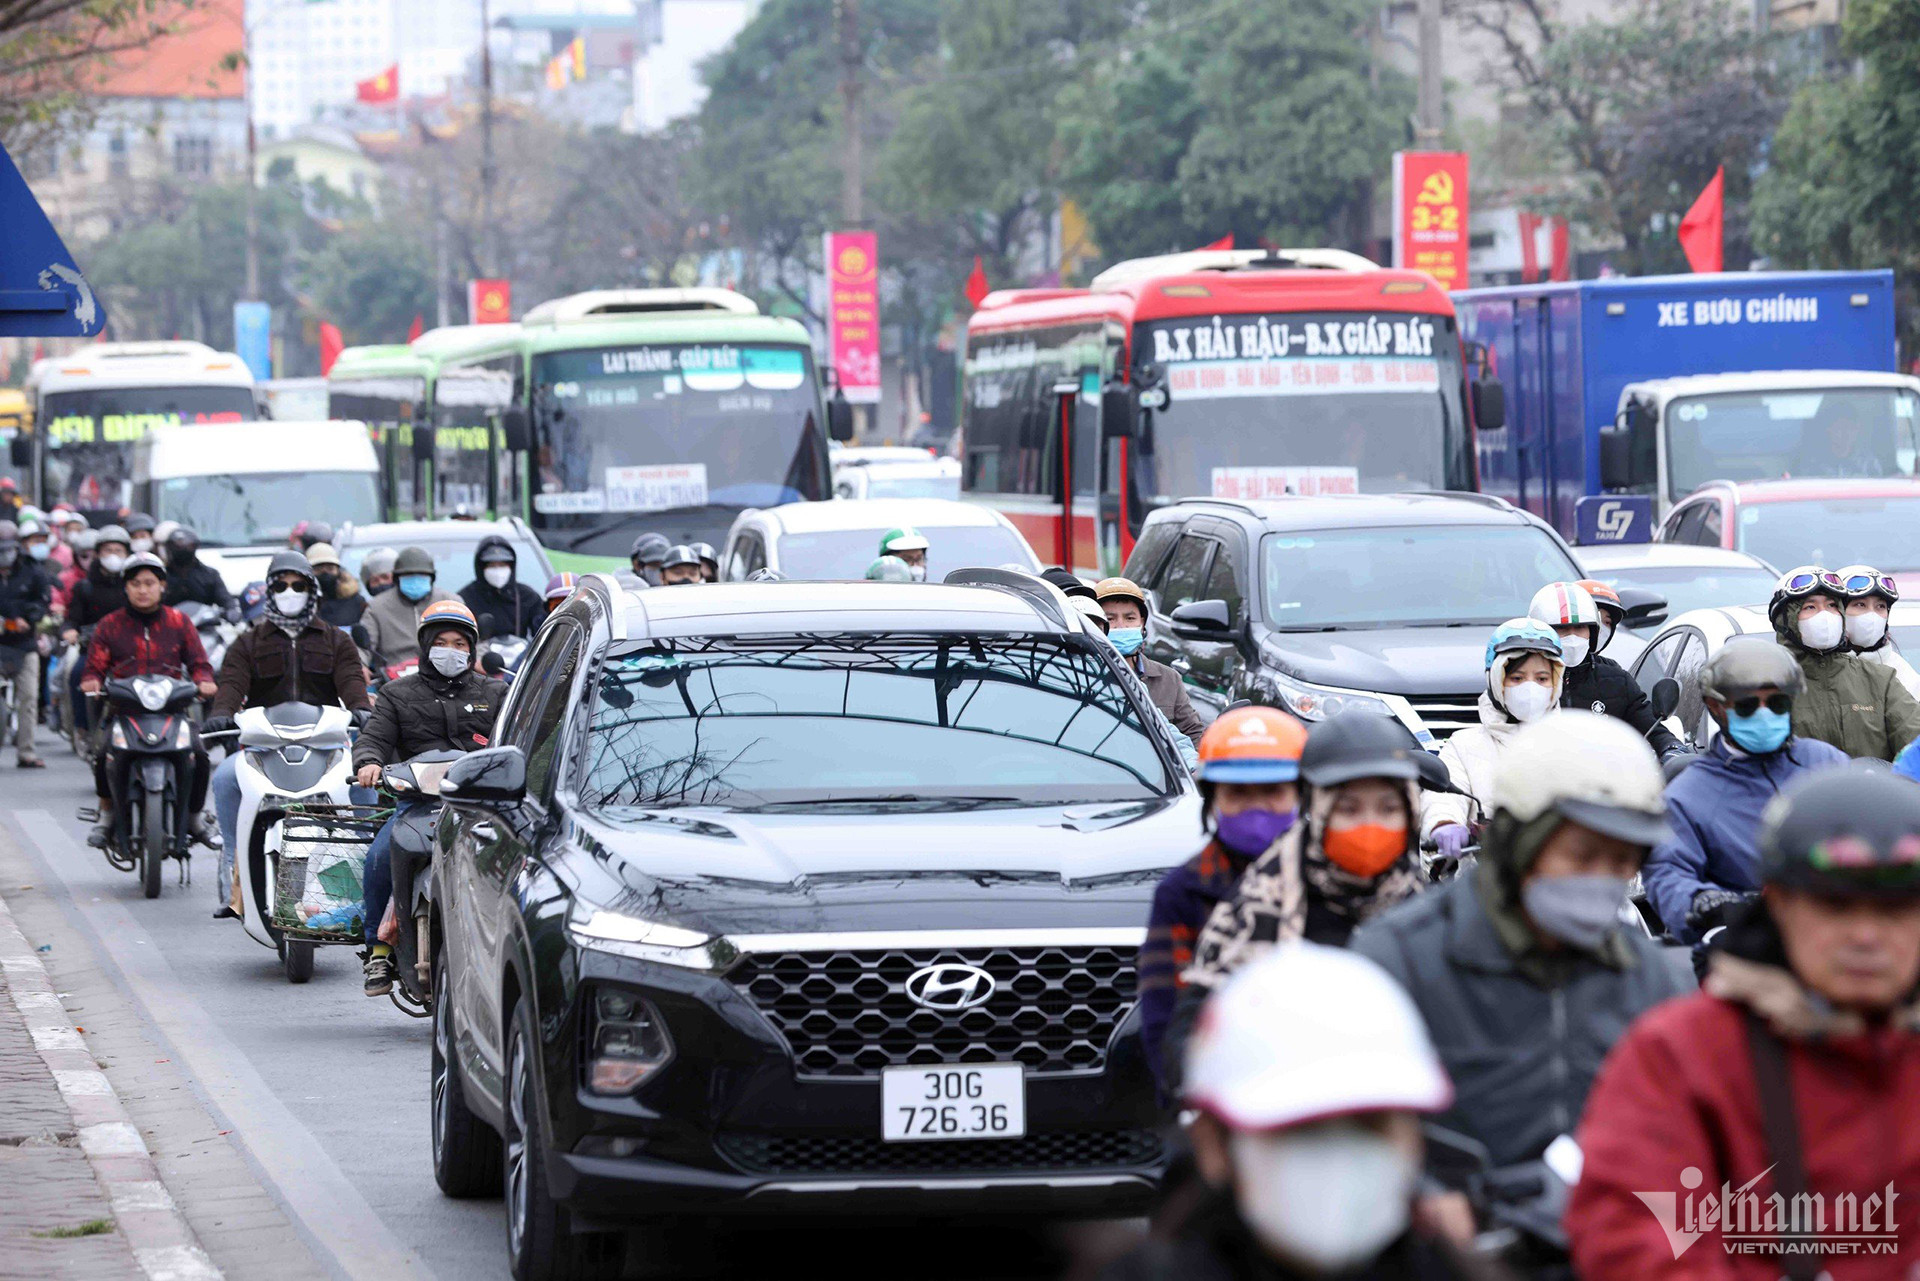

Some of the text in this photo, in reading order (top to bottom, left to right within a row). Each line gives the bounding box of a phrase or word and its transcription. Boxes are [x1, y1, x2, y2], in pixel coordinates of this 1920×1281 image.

[1412, 205, 1459, 230] 3-2
[1658, 292, 1818, 326] XE BƯU CHÍNH
[1153, 329, 1193, 362] B.X
[1194, 316, 1237, 360] HẢI
[1342, 315, 1393, 355] GIÁP
[1394, 317, 1433, 356] BÁT
[1597, 501, 1634, 540] G7
[924, 1072, 983, 1100] 30G
[899, 1104, 1008, 1135] 726.36
